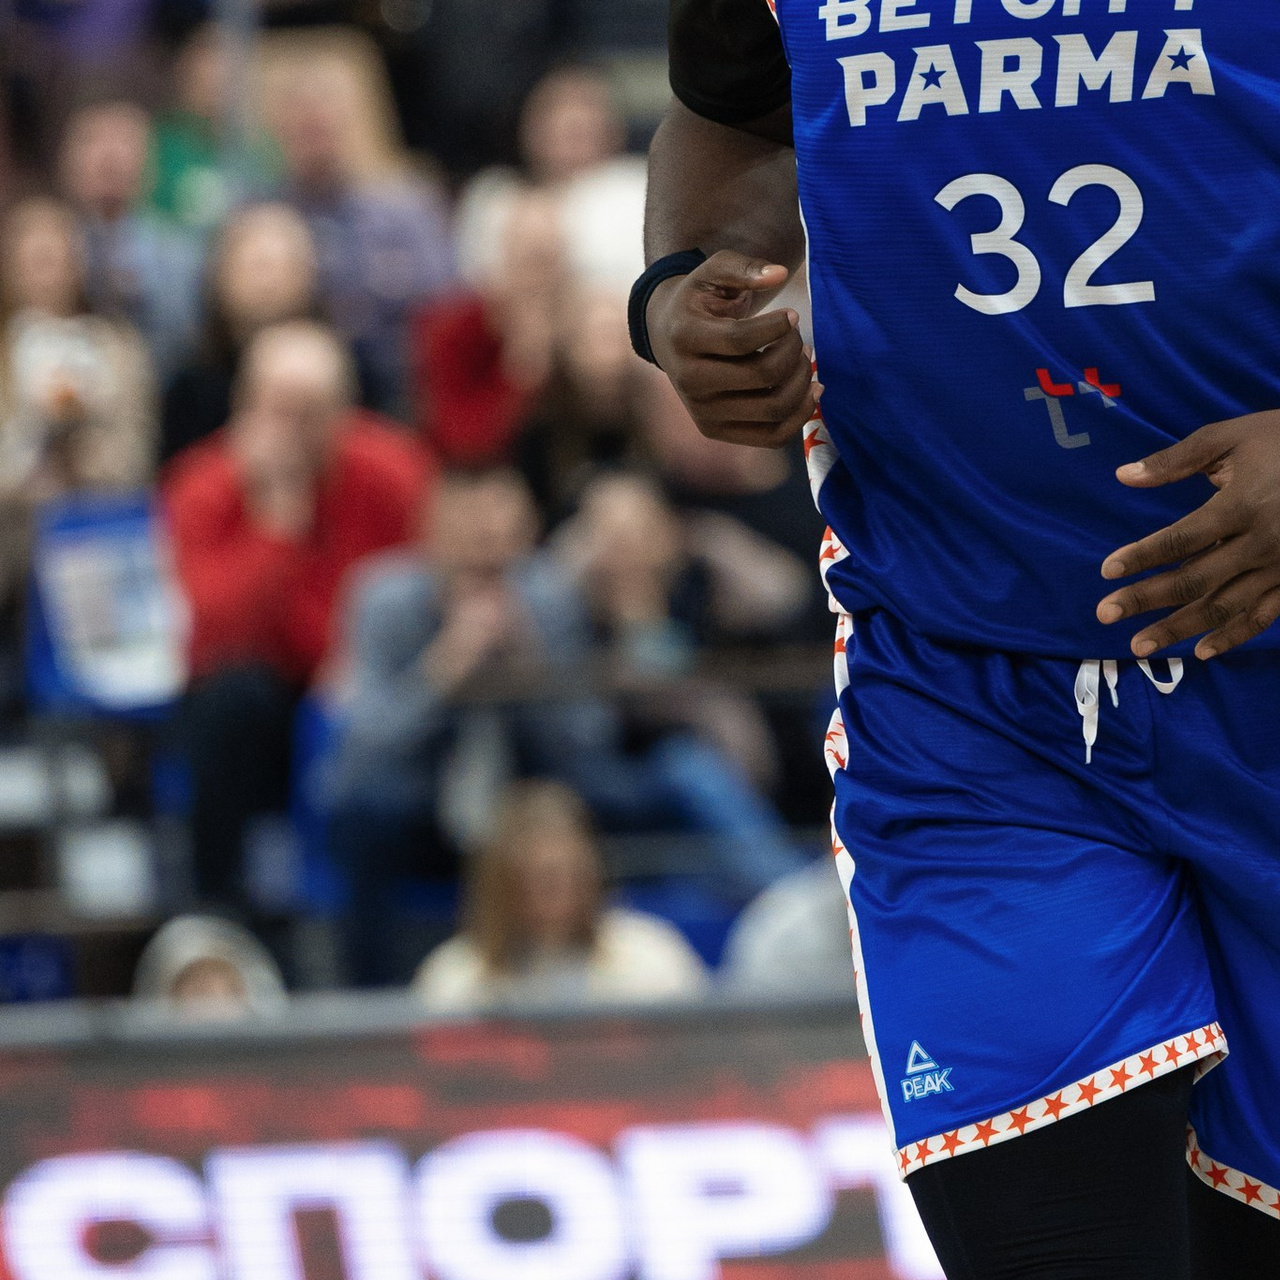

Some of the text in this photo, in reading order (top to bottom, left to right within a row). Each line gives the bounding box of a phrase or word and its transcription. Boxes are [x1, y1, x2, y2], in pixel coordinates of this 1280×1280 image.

[836, 28, 1216, 127] PARMA
[934, 163, 1156, 316] 32
[901, 1067, 955, 1103] PEAK
